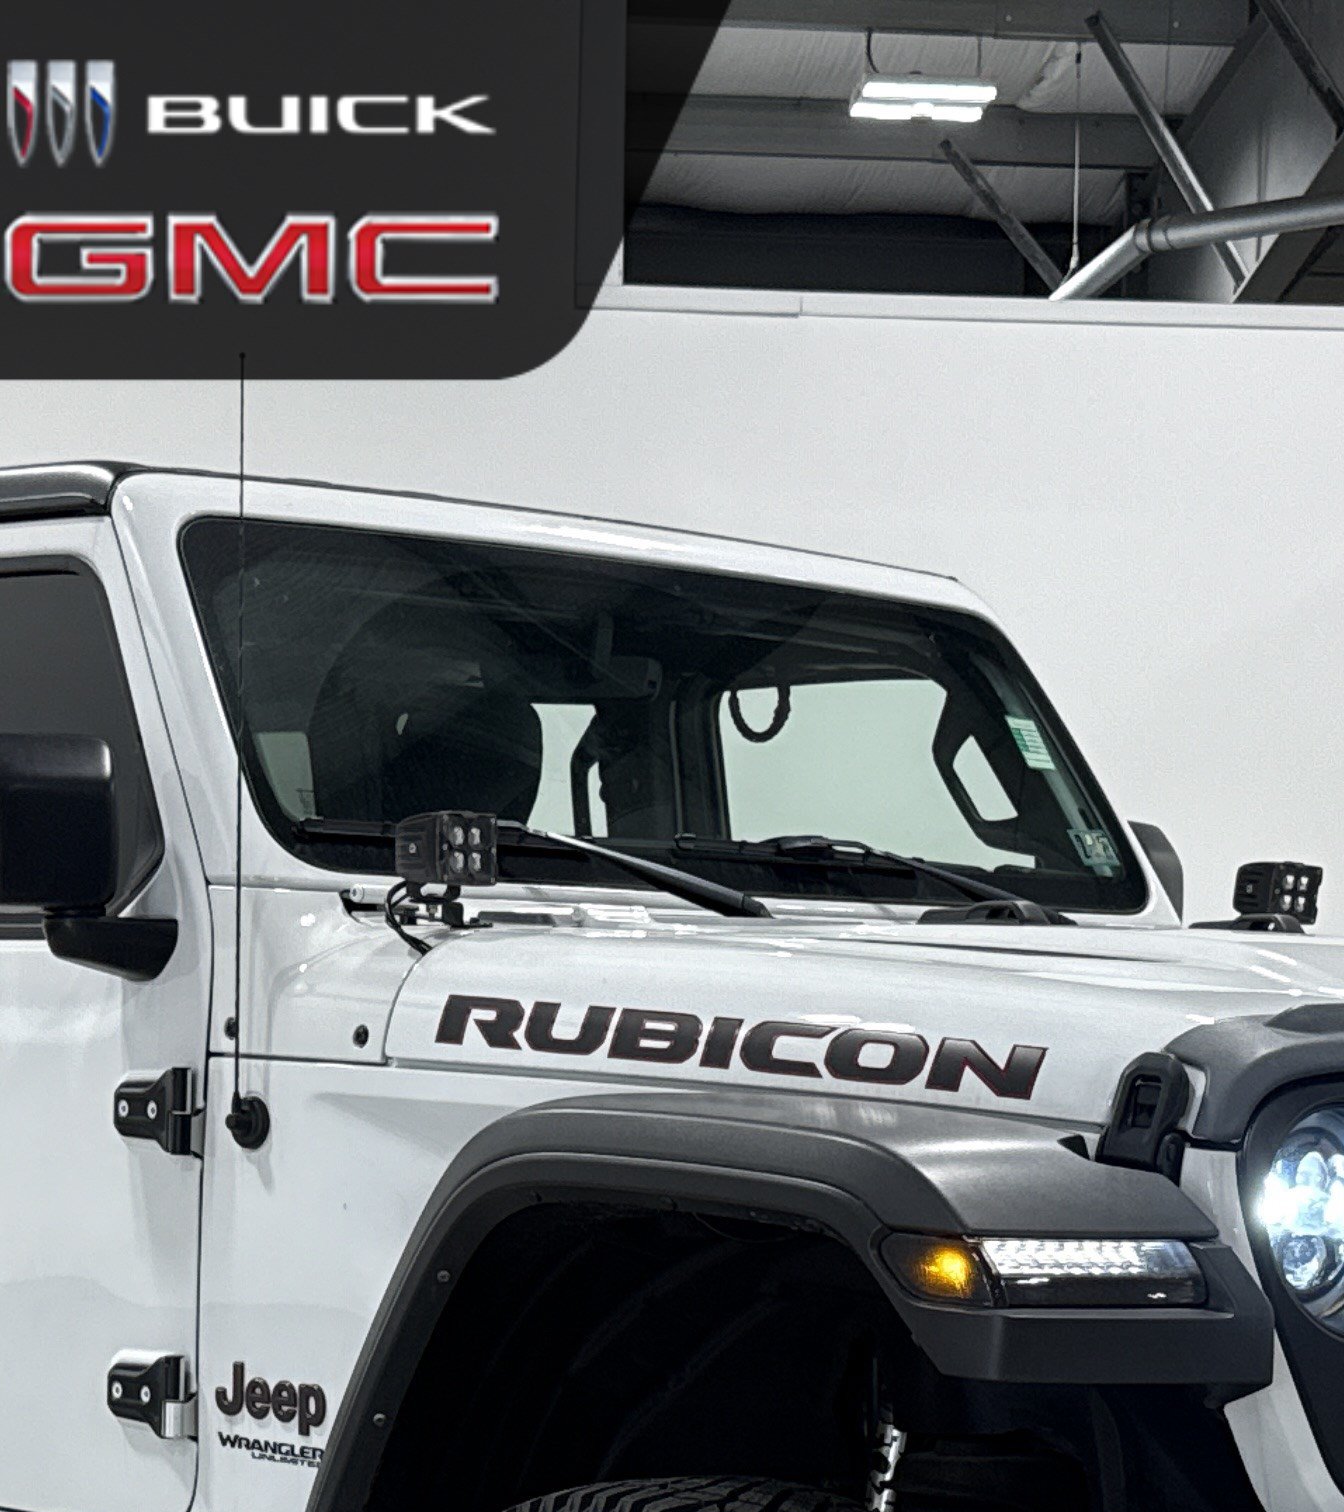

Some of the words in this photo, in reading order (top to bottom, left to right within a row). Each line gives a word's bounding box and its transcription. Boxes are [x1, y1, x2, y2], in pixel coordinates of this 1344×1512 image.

[434, 993, 1049, 1101] RUBICON
[214, 1360, 327, 1437] Jeep
[217, 1431, 326, 1461] WRANGLER
